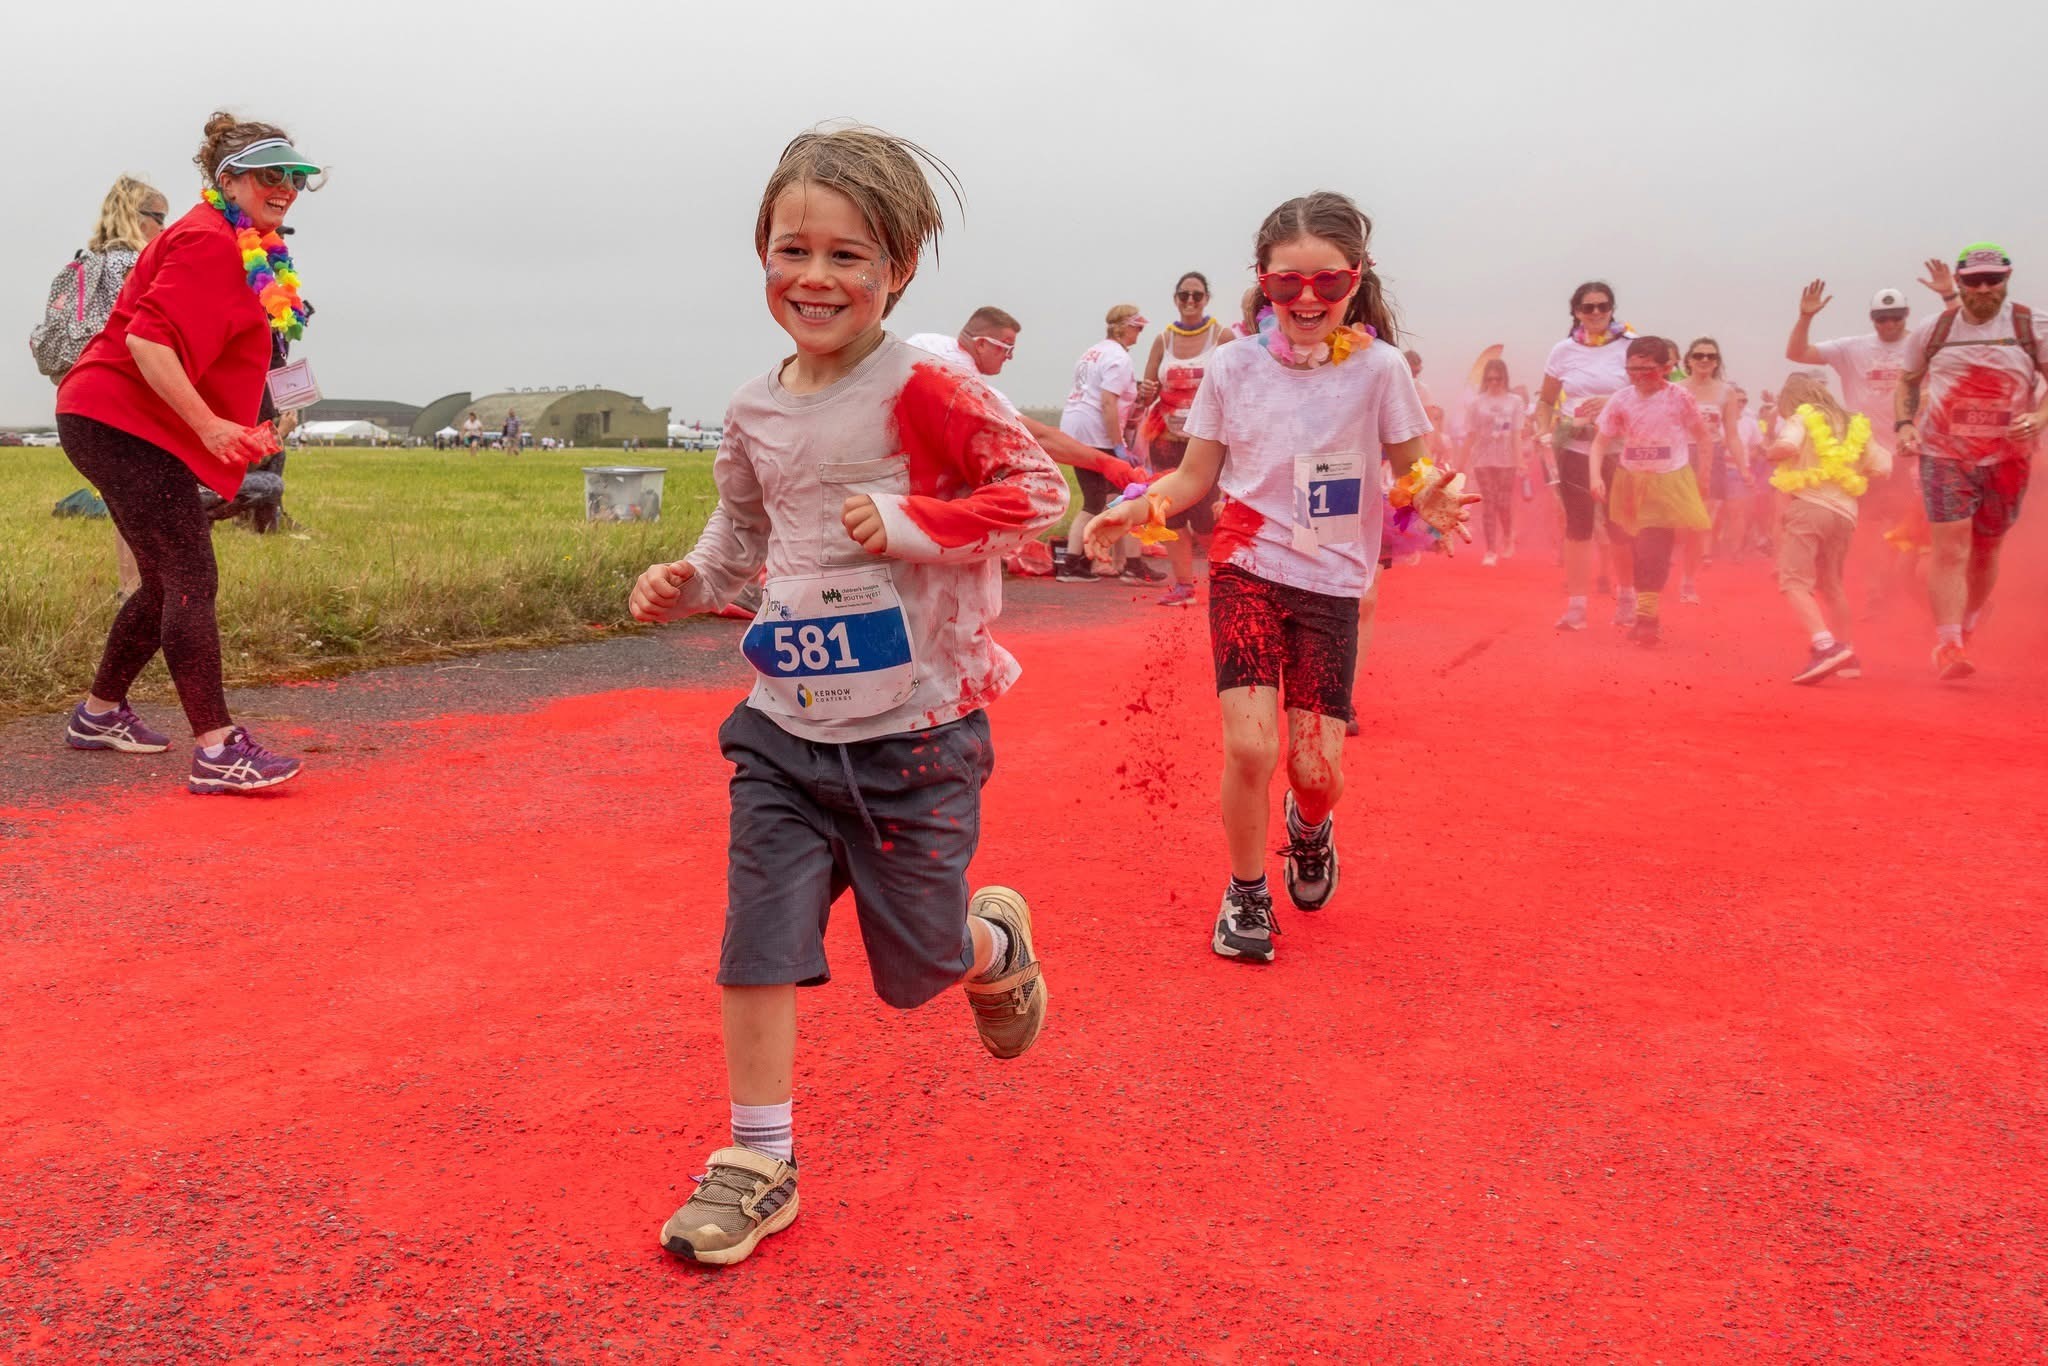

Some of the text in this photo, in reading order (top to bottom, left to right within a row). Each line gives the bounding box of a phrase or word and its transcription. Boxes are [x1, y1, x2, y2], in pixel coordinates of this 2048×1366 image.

[1967, 411, 1998, 425] 894
[843, 591, 881, 602] SOUTH WEST
[774, 621, 860, 673] 581
[814, 688, 850, 697] KERNOW
